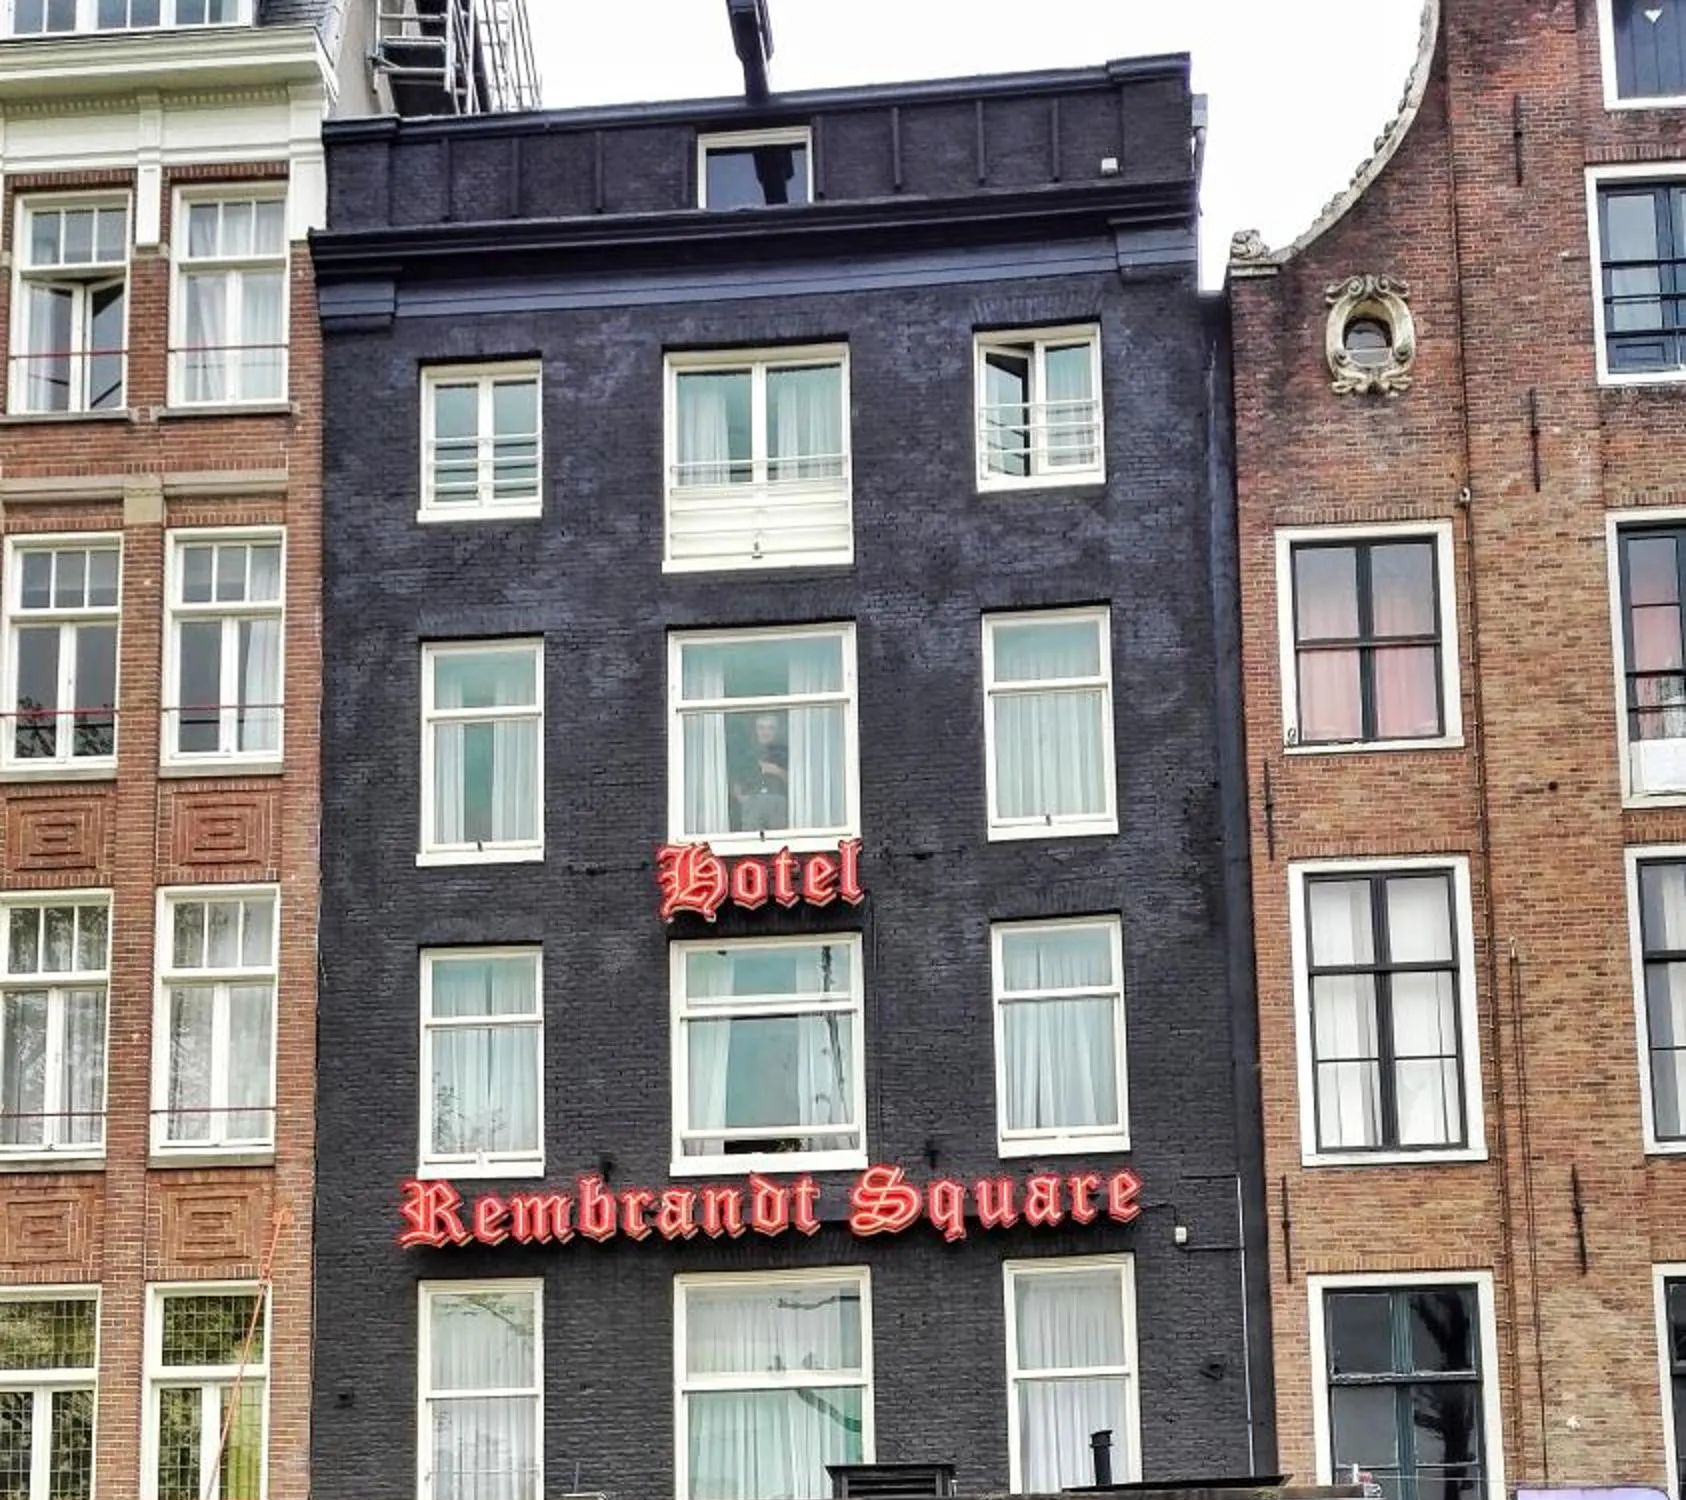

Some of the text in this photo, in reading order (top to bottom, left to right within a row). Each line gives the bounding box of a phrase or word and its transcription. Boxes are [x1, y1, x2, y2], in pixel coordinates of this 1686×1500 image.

[656, 839, 866, 922] Hotel
[399, 1164, 1143, 1249] Rembrandt Square
